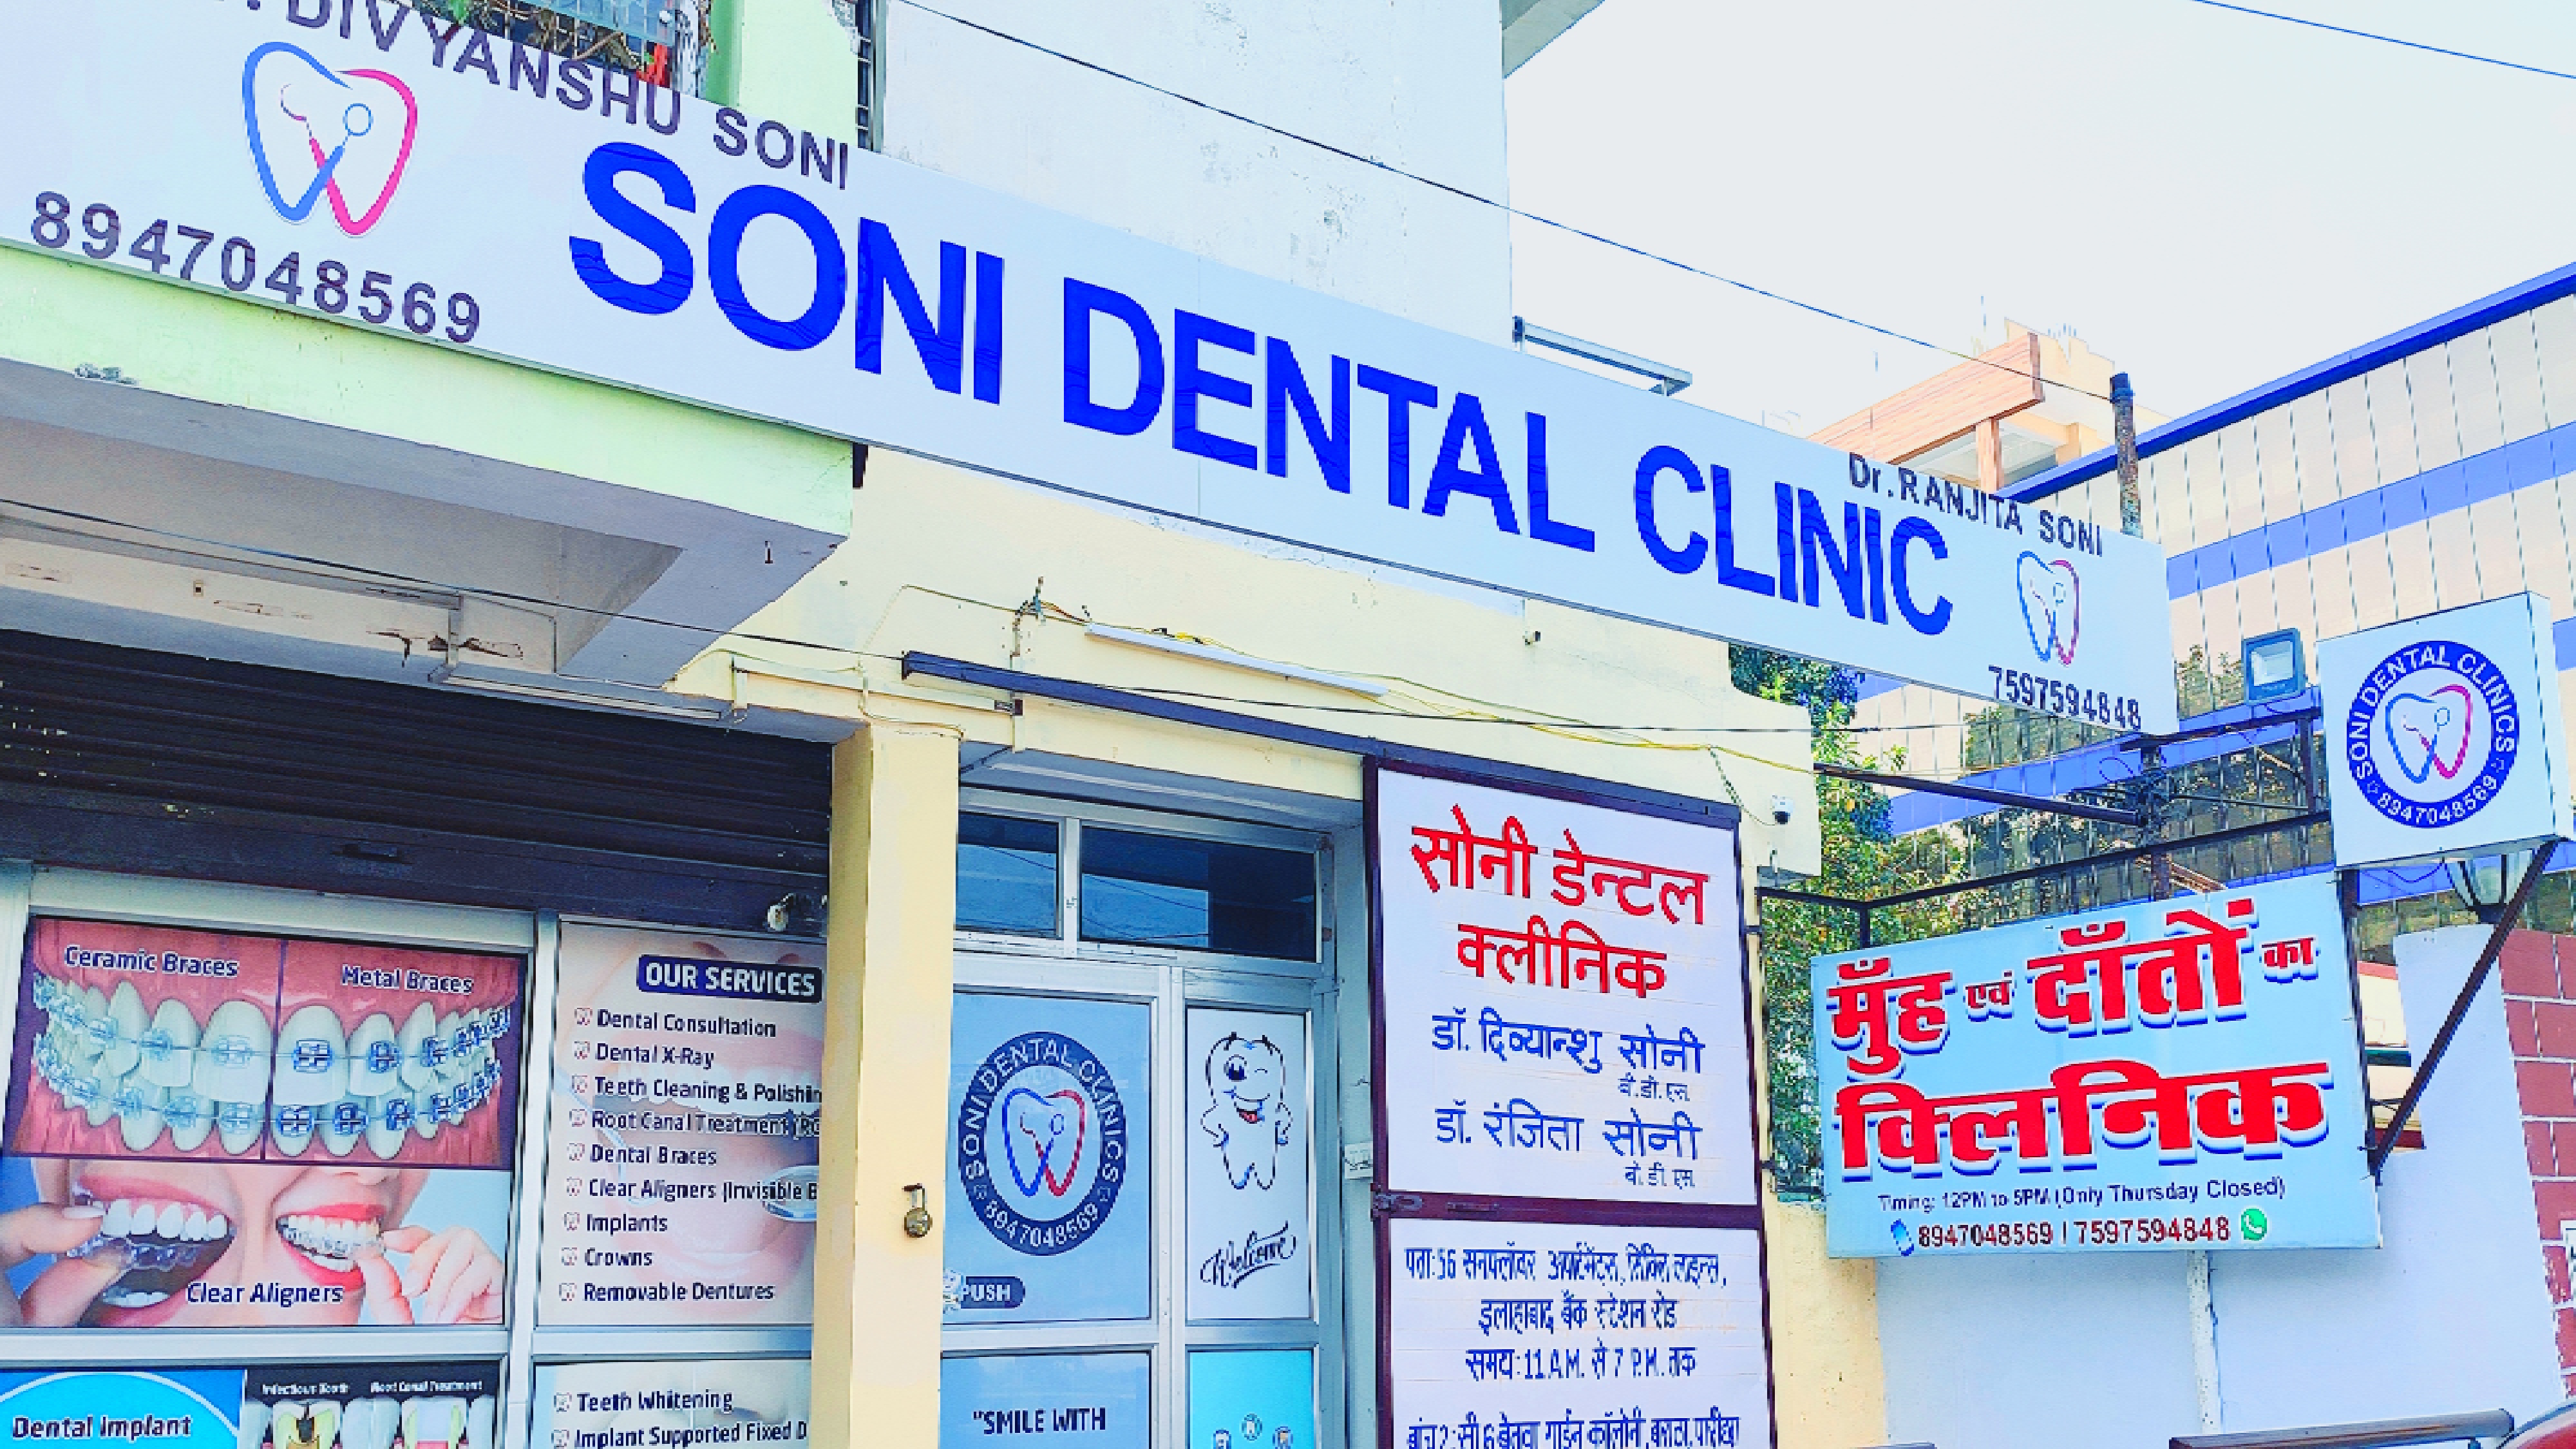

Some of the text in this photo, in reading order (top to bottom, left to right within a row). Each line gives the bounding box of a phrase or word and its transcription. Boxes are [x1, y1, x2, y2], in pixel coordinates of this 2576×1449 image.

[712, 107, 848, 191] SONI
[30, 191, 480, 343] 8947048569
[569, 142, 1953, 636] SONI DENTAL CLINIC
[2039, 509, 2103, 558] SONI
[1988, 664, 2141, 732] 7597594848
[2349, 645, 2515, 781] SONI DENTAL CLINICS
[2376, 775, 2497, 824] 8947048569
[1410, 803, 1710, 925] सोनी डेन्टल
[64, 944, 240, 978] Ceramic Braces
[1457, 914, 1667, 999] क्लीनिक
[341, 964, 474, 995] Metal Braces
[646, 962, 816, 996] OUR SERVICES
[1965, 971, 2014, 1019] एवं
[2261, 936, 2318, 983] का
[597, 1008, 777, 1037] Dental Consultation
[1431, 1005, 1470, 1051] डॉ.
[1618, 1023, 1706, 1074] सोनी
[594, 1043, 715, 1070] Dental X-Ray
[594, 1076, 822, 1104] Teeth Cleaning & Polishin
[592, 1110, 636, 1130] Root
[641, 1112, 692, 1130] Canal
[697, 1113, 788, 1135] Treatment
[962, 1037, 1124, 1182] SONI DENTAL CLINICS
[1835, 1059, 2334, 1182] क्लिनिक
[1434, 1097, 1703, 1160] डॉ. रंजिता सोनी
[590, 1142, 717, 1166] Dental Braces
[589, 1177, 636, 1197] Clear
[640, 1179, 717, 1202] Aligners
[723, 1180, 802, 1203] (Invisible
[1942, 1192, 1987, 1208] 12PM
[1991, 1192, 2009, 1208] to
[2013, 1189, 2051, 1206] 5PM
[2056, 1186, 2103, 1209] (Only
[2107, 1182, 2199, 1204] Thursday
[2206, 1176, 2286, 1200] Closed)
[586, 1213, 668, 1236] Implants
[984, 1202, 1099, 1248] 8947048569
[1918, 1221, 2054, 1247] 8947048569
[2073, 1215, 2231, 1245] 7597594848
[584, 1247, 653, 1267] Crowns
[186, 1280, 344, 1308] Clear Aligners
[583, 1282, 775, 1302] Removable Dentures
[1614, 1348, 1624, 1379] 7
[1669, 1347, 1698, 1378] तक
[577, 1388, 733, 1412] Teeth Whitening
[13, 1414, 192, 1443] Dental Implant
[574, 1426, 645, 1449] Implant
[649, 1424, 741, 1448] Supported
[746, 1421, 792, 1441] Fixed
[1052, 1407, 1106, 1432] WITH
